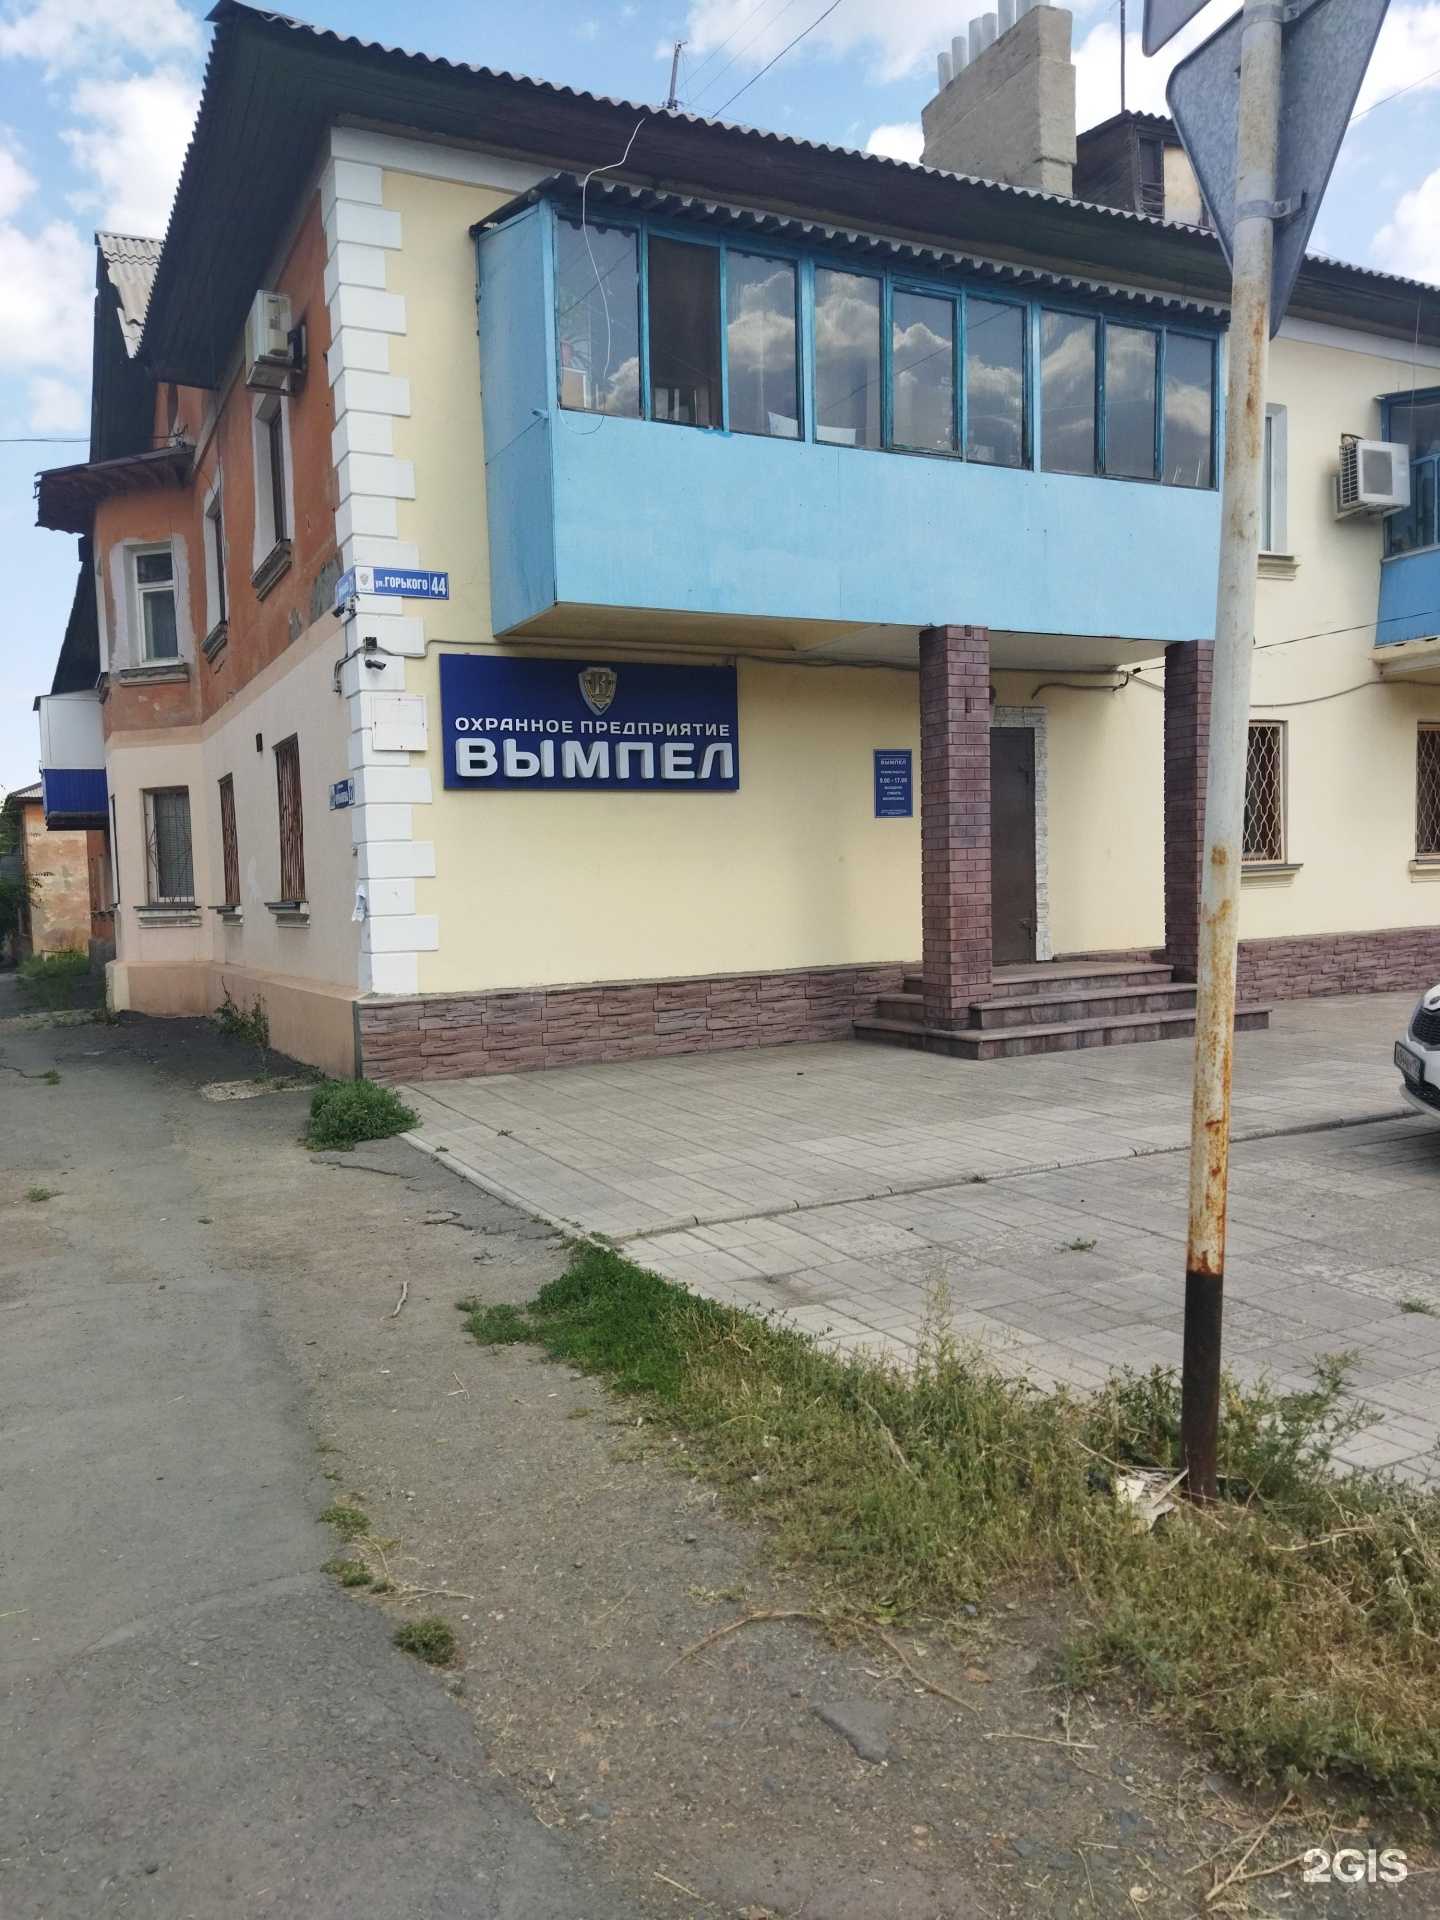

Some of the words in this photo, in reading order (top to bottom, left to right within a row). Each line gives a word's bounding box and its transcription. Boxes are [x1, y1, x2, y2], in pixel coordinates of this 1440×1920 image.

[431, 576, 447, 595] 44
[455, 717, 574, 734] ОХРАННОЕ
[580, 720, 730, 737] ПРЕДПРИЯТИЕ
[455, 737, 734, 780] ВЫМПЕЛ
